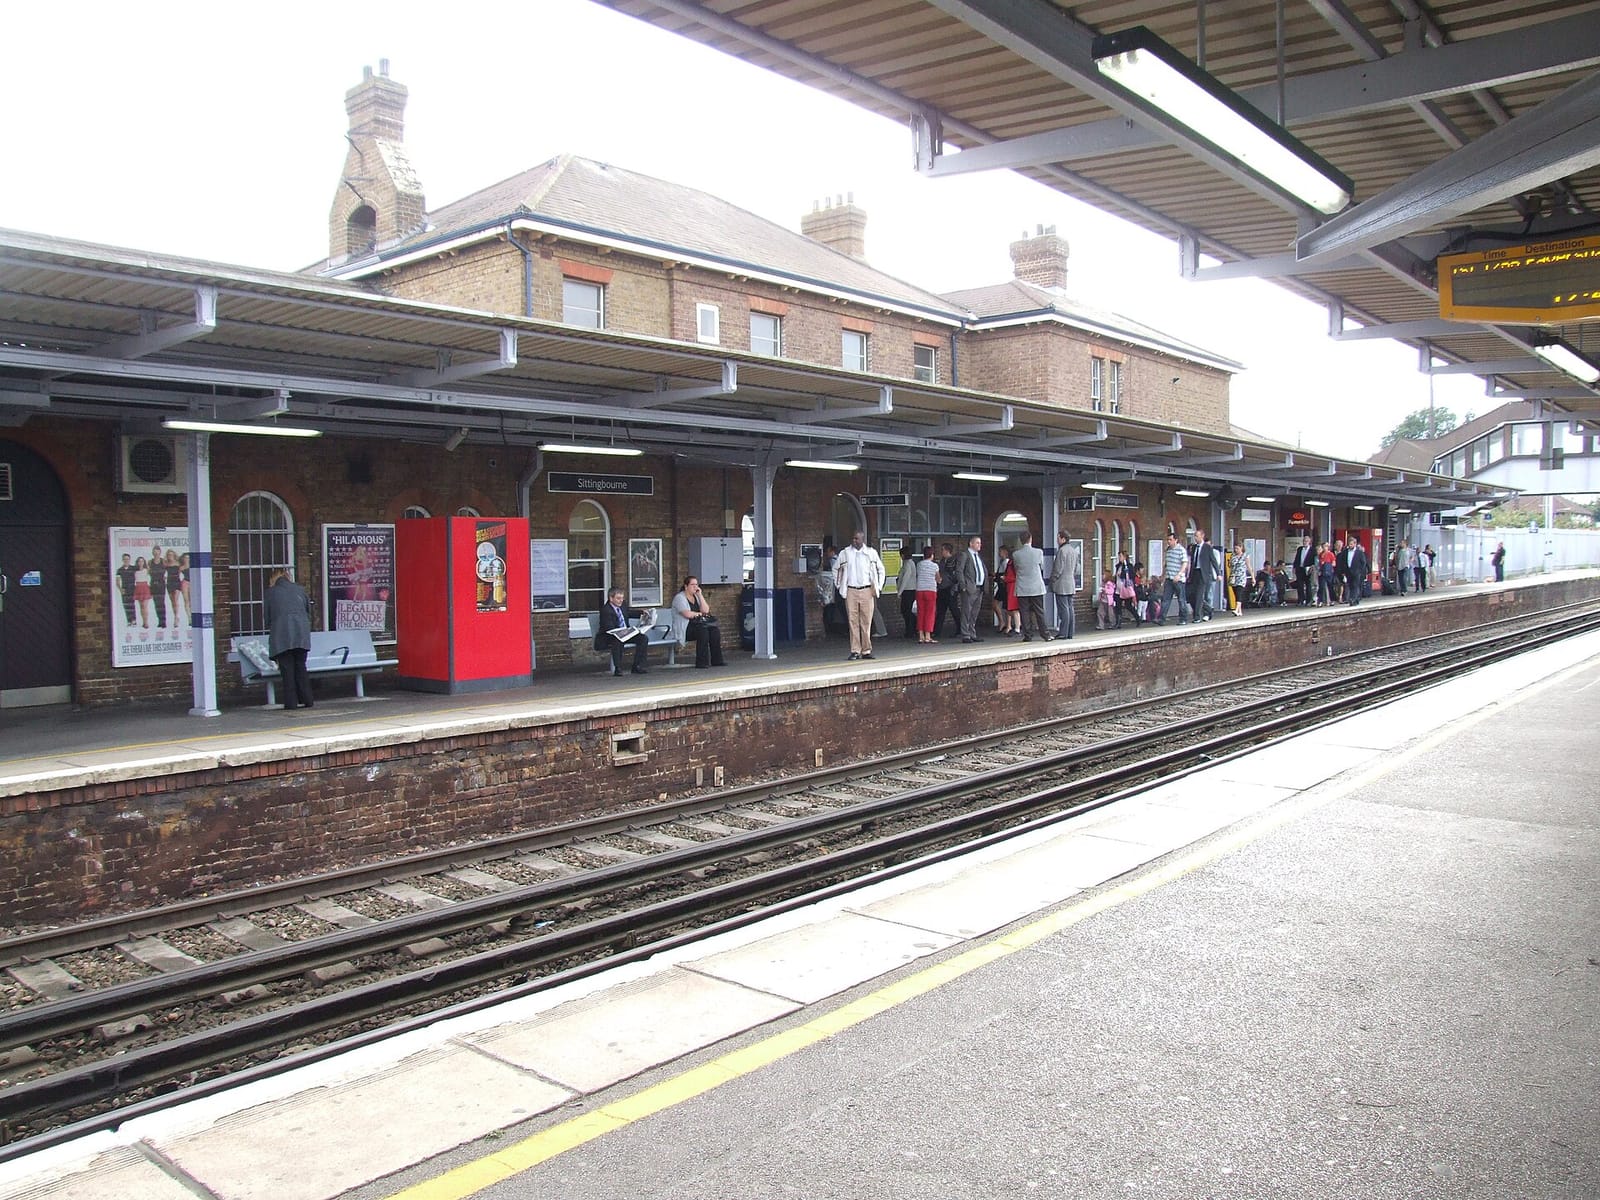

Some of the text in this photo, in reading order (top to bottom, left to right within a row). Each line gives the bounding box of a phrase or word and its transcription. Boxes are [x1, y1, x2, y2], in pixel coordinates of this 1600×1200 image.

[1482, 240, 1585, 260] Time Destination
[577, 478, 628, 491] Sittingbourne
[341, 603, 383, 614] LEGALLY
[341, 612, 383, 623] BLONDE
